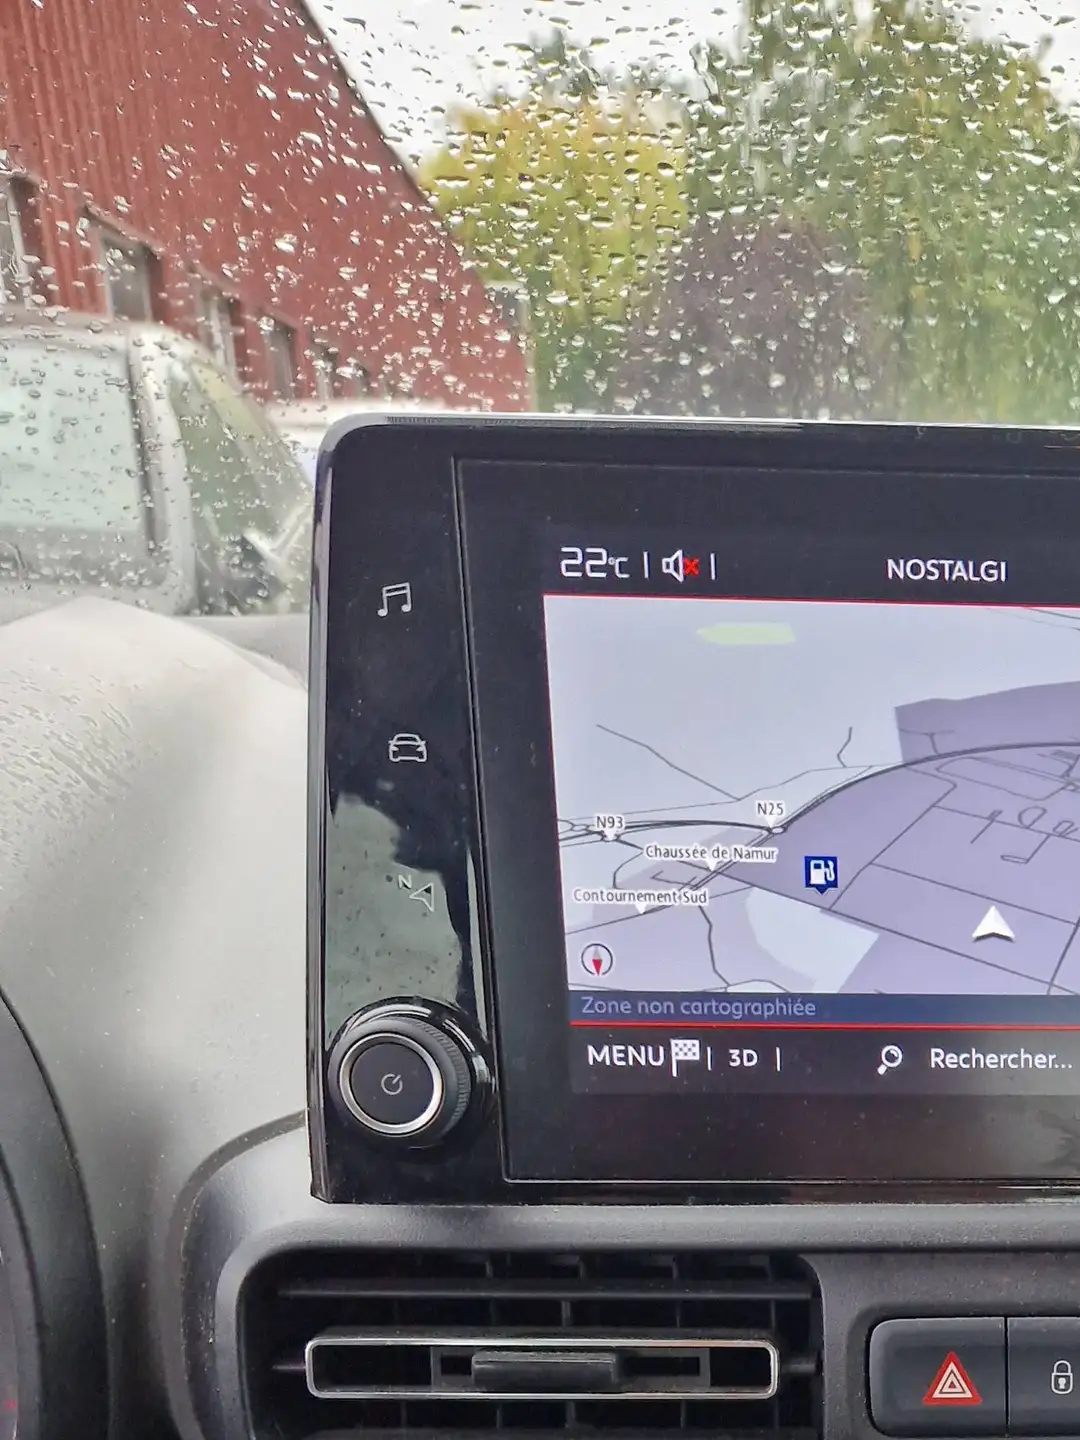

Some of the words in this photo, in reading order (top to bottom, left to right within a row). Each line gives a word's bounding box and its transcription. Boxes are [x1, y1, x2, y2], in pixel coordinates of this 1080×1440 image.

[886, 558, 1008, 582] NOSTALGI
[757, 802, 784, 816] N25
[596, 816, 624, 829] N93
[645, 845, 708, 860] Chaussée
[711, 845, 729, 860] de
[733, 848, 776, 861] Namur
[573, 889, 678, 904] Contournement
[683, 890, 708, 904] Sud
[581, 996, 632, 1015] Zone
[637, 1000, 675, 1015] non
[680, 998, 817, 1020] cartographiée
[587, 1045, 665, 1067] MENU
[728, 1048, 759, 1067] 3D
[929, 1048, 1073, 1069] Rechercher...
